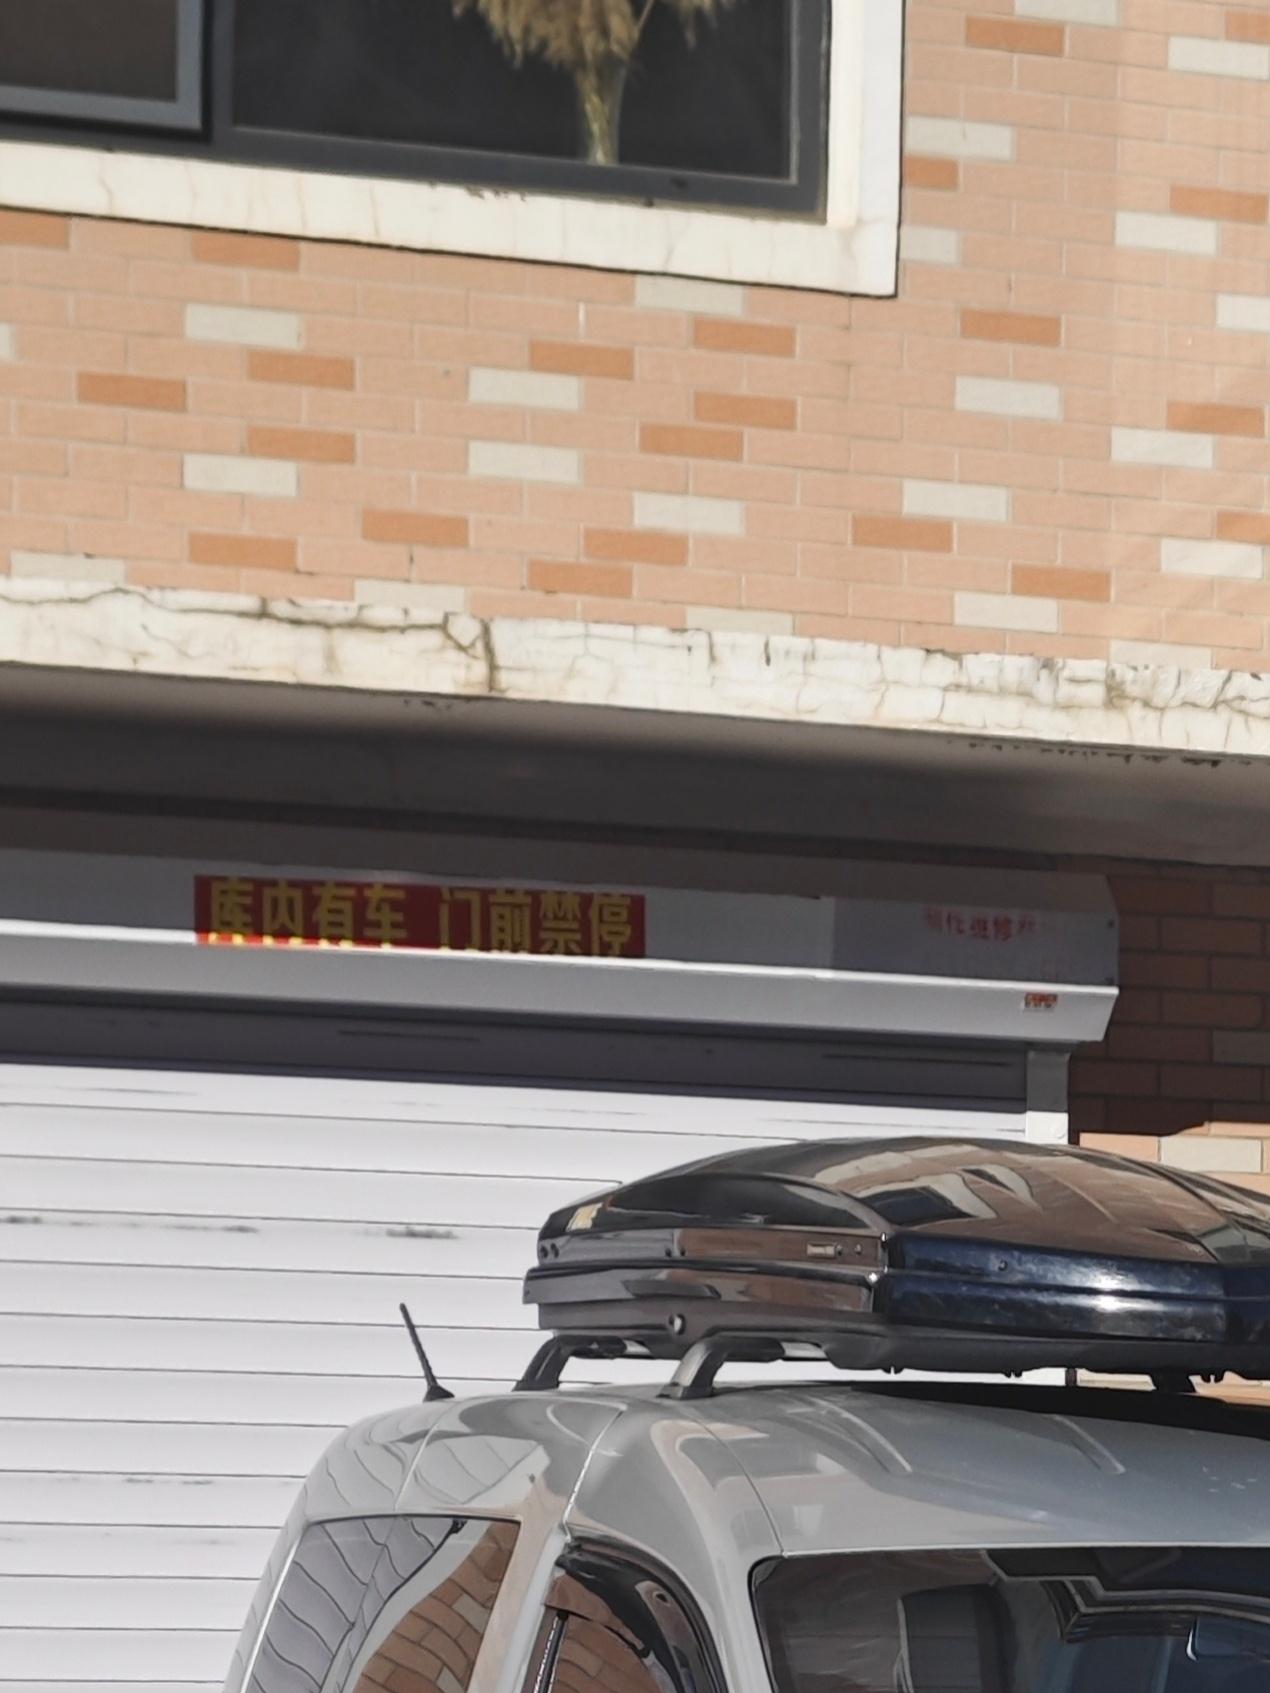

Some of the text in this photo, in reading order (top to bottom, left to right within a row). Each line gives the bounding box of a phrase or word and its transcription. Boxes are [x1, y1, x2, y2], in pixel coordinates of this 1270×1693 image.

[208, 877, 632, 957] 库内有车 门前禁停
